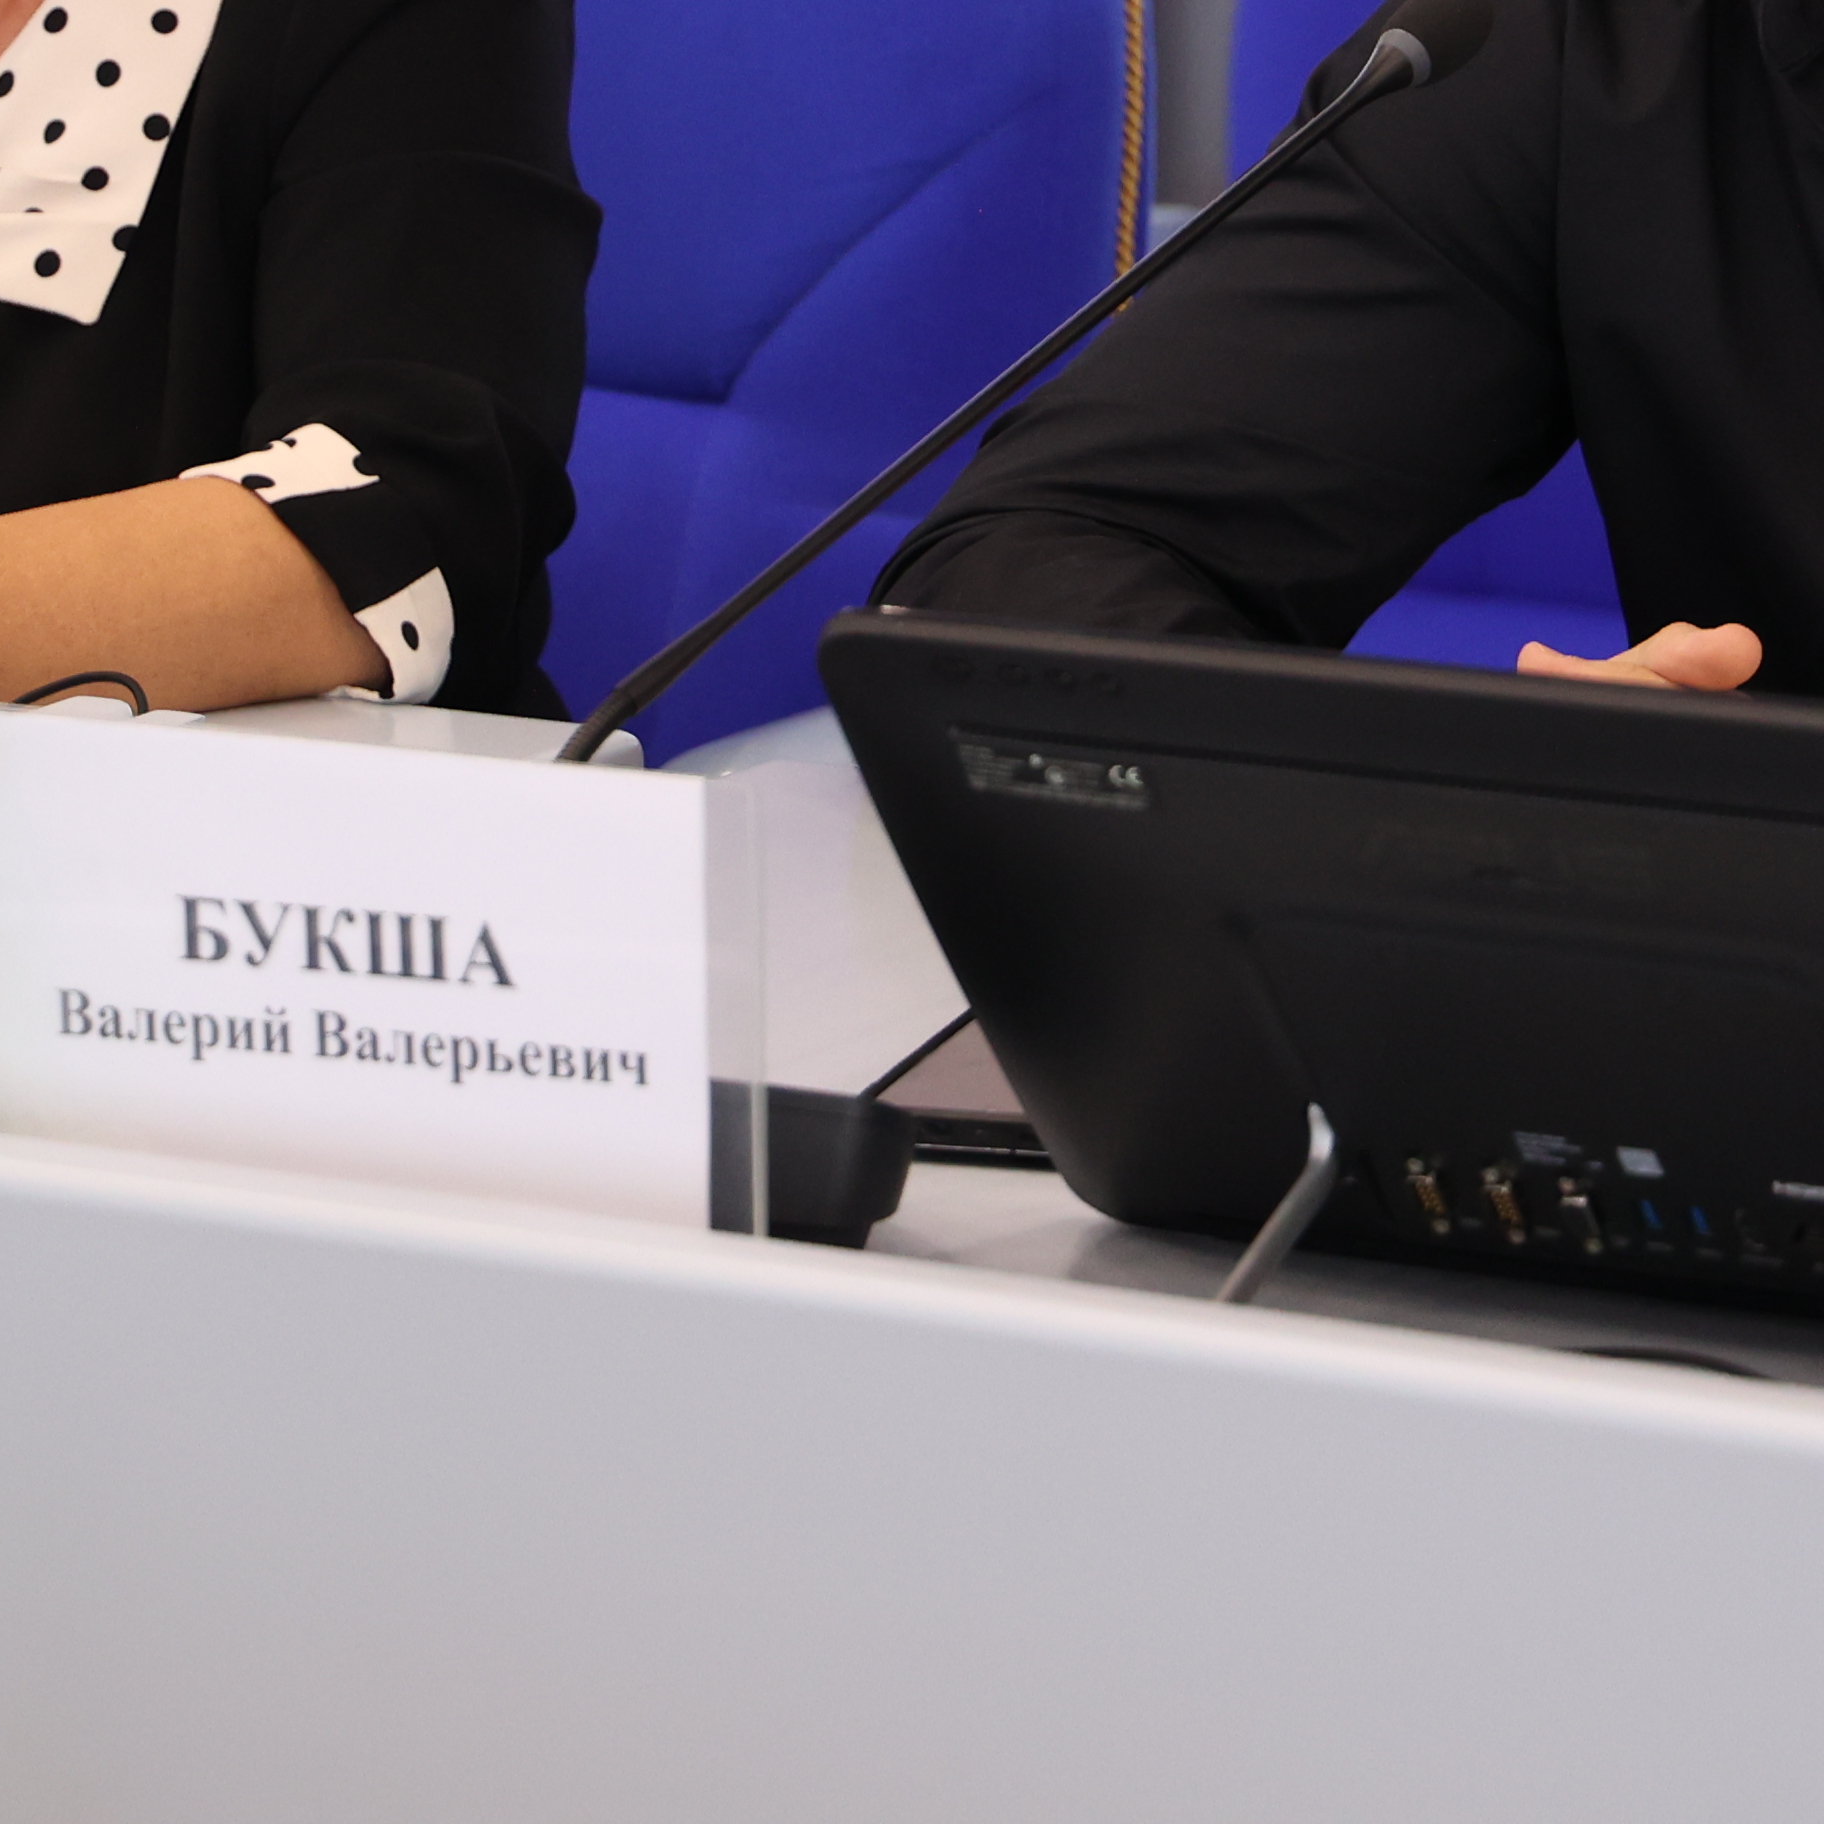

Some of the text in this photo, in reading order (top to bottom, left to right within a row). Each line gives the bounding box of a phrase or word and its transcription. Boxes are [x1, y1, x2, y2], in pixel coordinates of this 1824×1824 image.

[179, 894, 515, 989] БУКША
[58, 988, 650, 1087] Валерий Валерьевич
